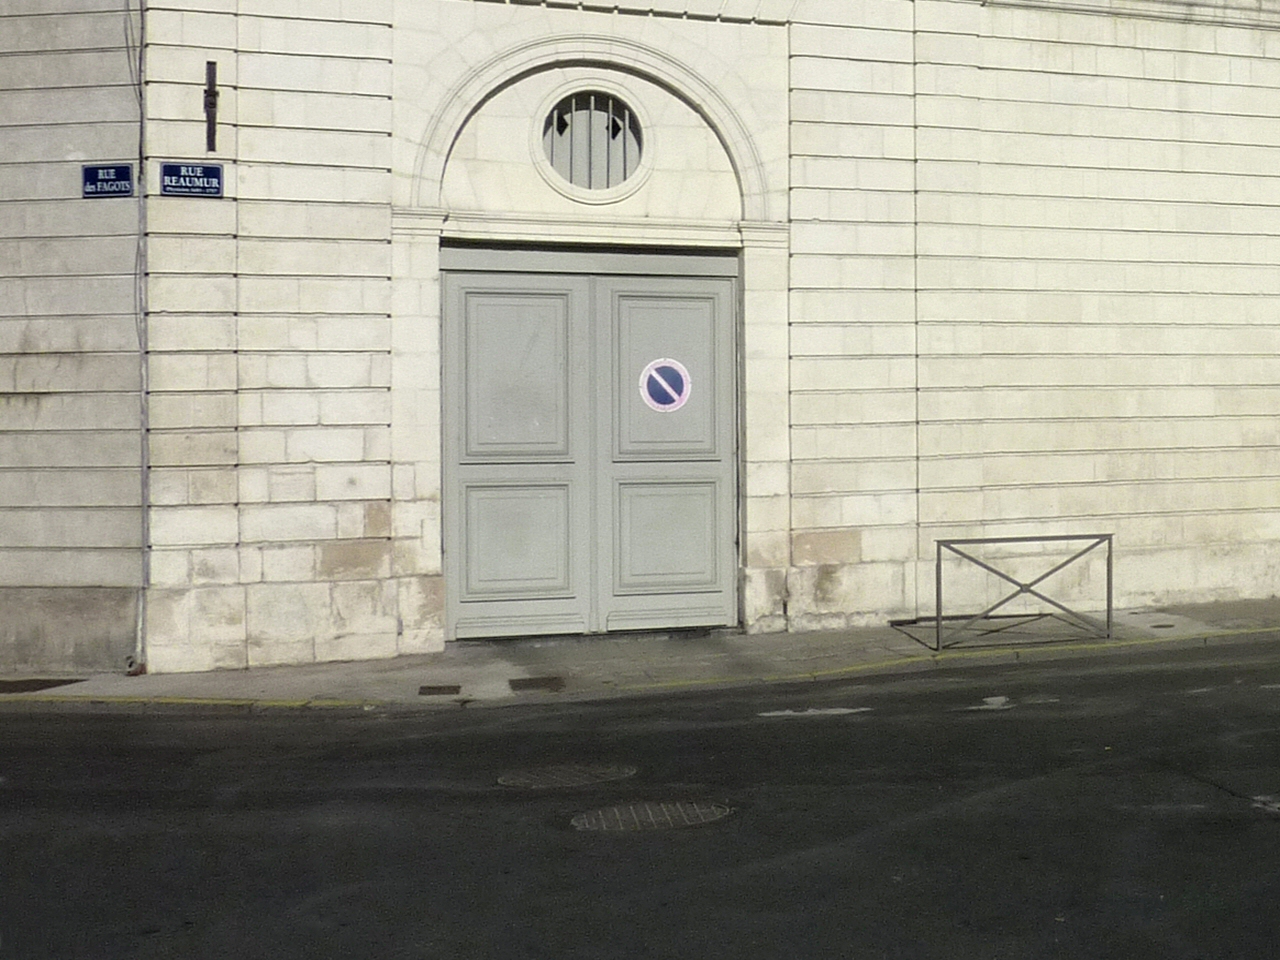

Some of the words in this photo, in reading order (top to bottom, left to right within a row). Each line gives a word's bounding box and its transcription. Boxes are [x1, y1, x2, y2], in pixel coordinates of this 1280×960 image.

[98, 169, 116, 179] RUE
[181, 167, 203, 176] RUE
[85, 182, 96, 192] des
[97, 181, 131, 192] FAGOTS
[164, 176, 219, 187] REAUMUR
